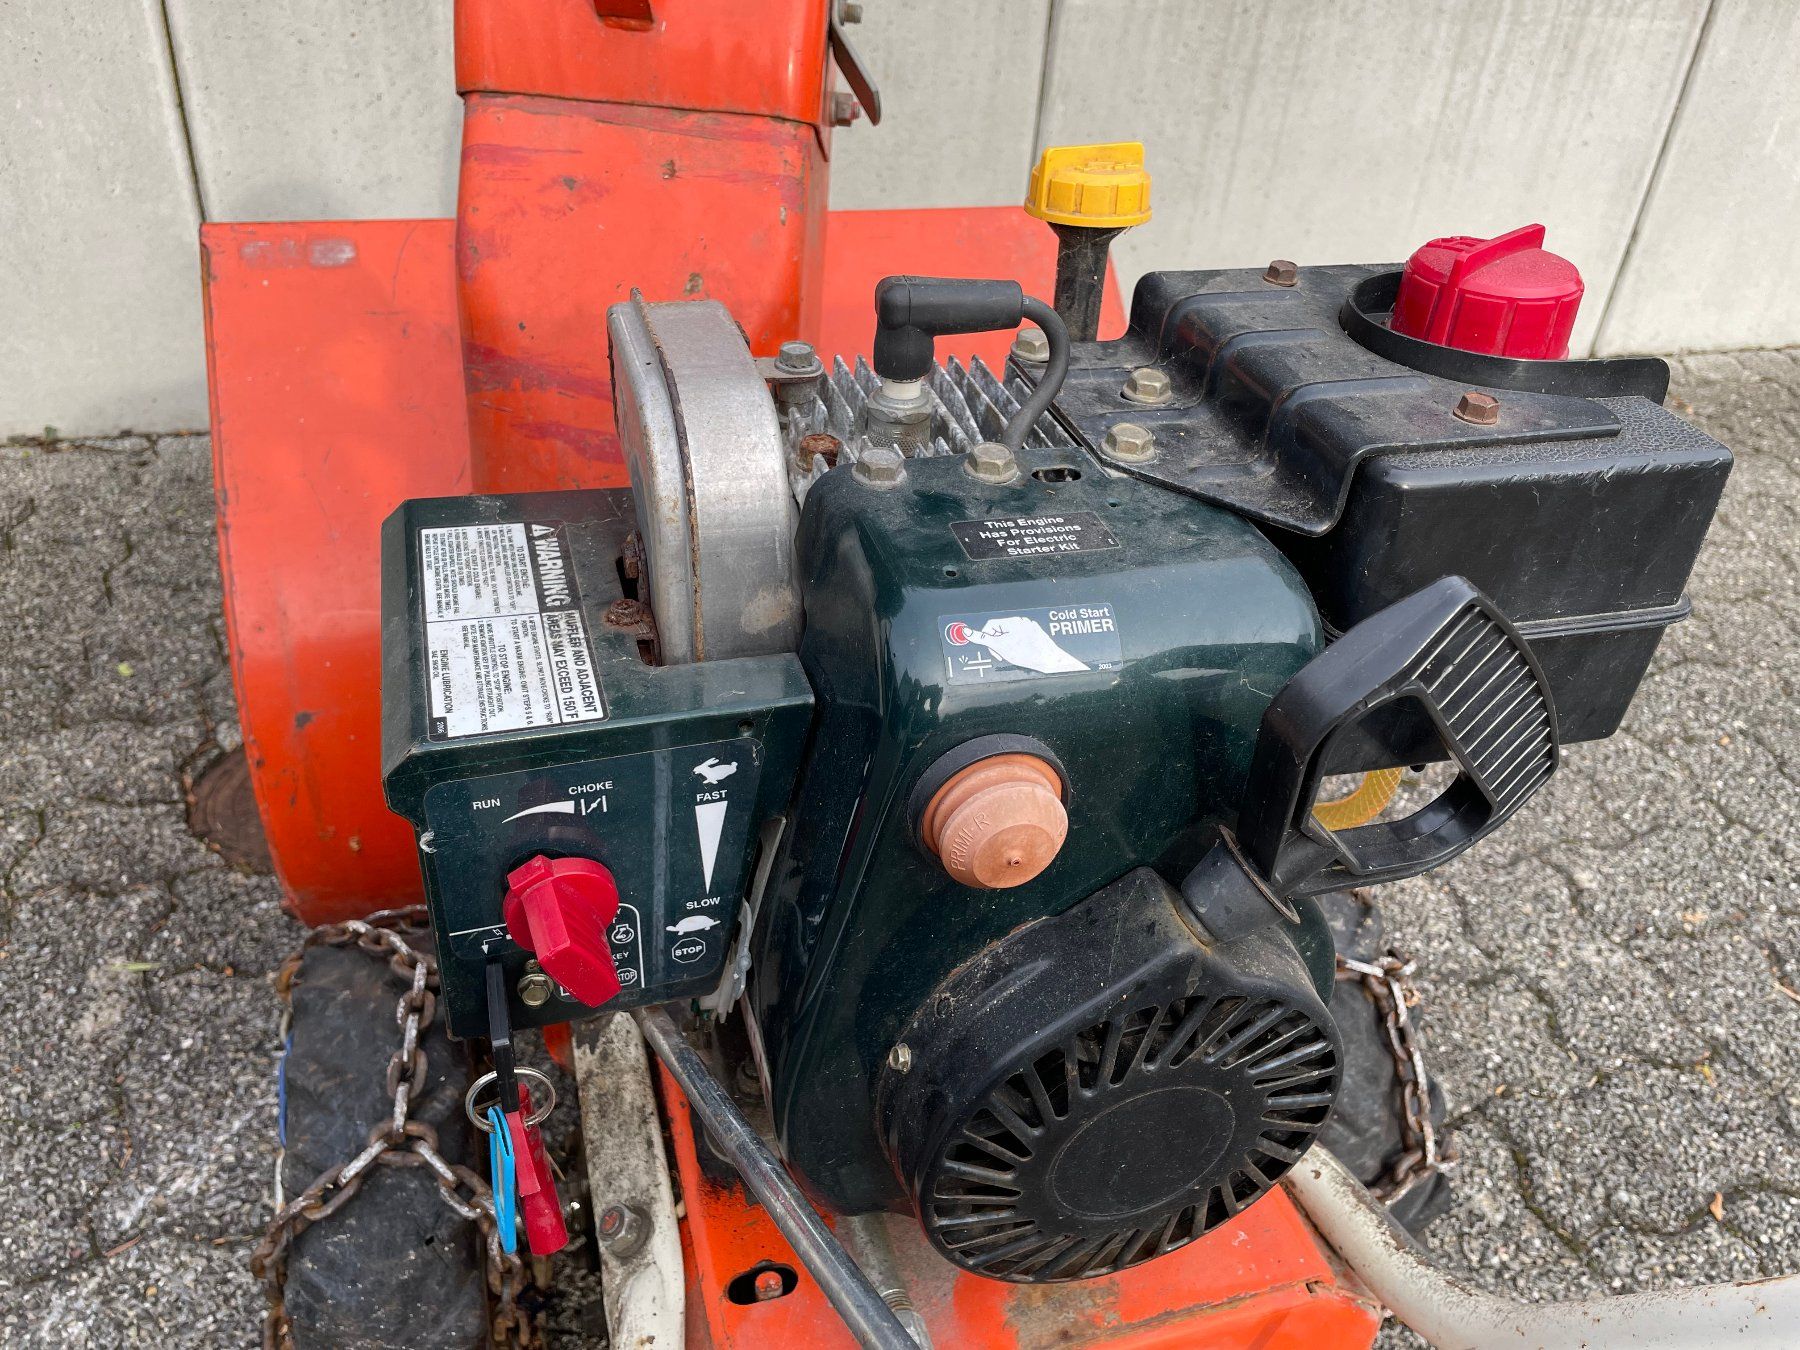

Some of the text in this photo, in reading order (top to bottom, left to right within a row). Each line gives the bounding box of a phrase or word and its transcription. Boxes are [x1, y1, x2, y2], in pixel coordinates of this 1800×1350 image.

[984, 517, 1064, 529] This Engine
[979, 525, 1081, 539] Has Provisions
[1026, 534, 1076, 545] Electric
[1007, 546, 1055, 555] Starter
[517, 552, 526, 566] START
[533, 537, 572, 606] WARNING
[1049, 607, 1109, 621] Cold Start
[545, 613, 562, 639] AREAS
[1049, 619, 1114, 636] PRIMER
[550, 639, 567, 657] MAY
[497, 644, 512, 694] TO STOP ENGINE:
[563, 612, 597, 713] MUFFLER AND ADJACENT
[439, 648, 453, 714] ENGINE LUBRICATION
[554, 659, 574, 693] EXCEED
[568, 781, 613, 795] CHOKE
[696, 790, 728, 801] FAST
[472, 798, 501, 810] RUN
[686, 897, 721, 909] SLOW
[674, 944, 703, 956] STOP
